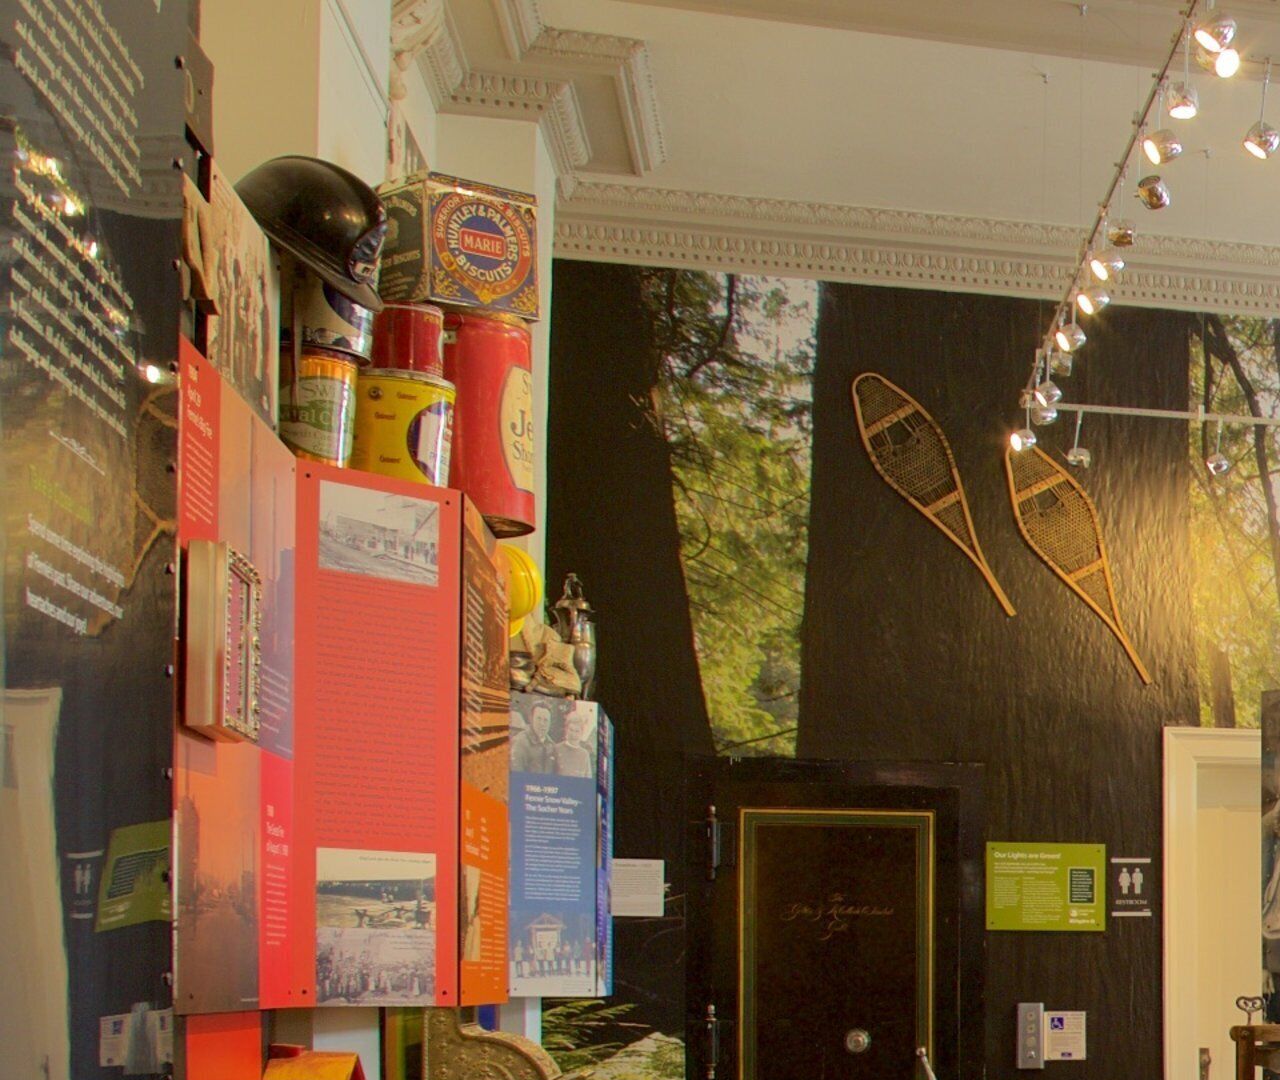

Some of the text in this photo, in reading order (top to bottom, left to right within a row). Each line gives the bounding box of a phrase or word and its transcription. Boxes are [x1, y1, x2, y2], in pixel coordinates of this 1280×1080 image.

[435, 197, 461, 238] SUPERIOR
[448, 204, 478, 249] HUNTLEY
[486, 208, 518, 262] PALMERS
[464, 234, 501, 254] MARIE
[455, 255, 513, 282] BISCUITS
[994, 851, 1007, 859] Our
[1007, 851, 1027, 860] Lights
